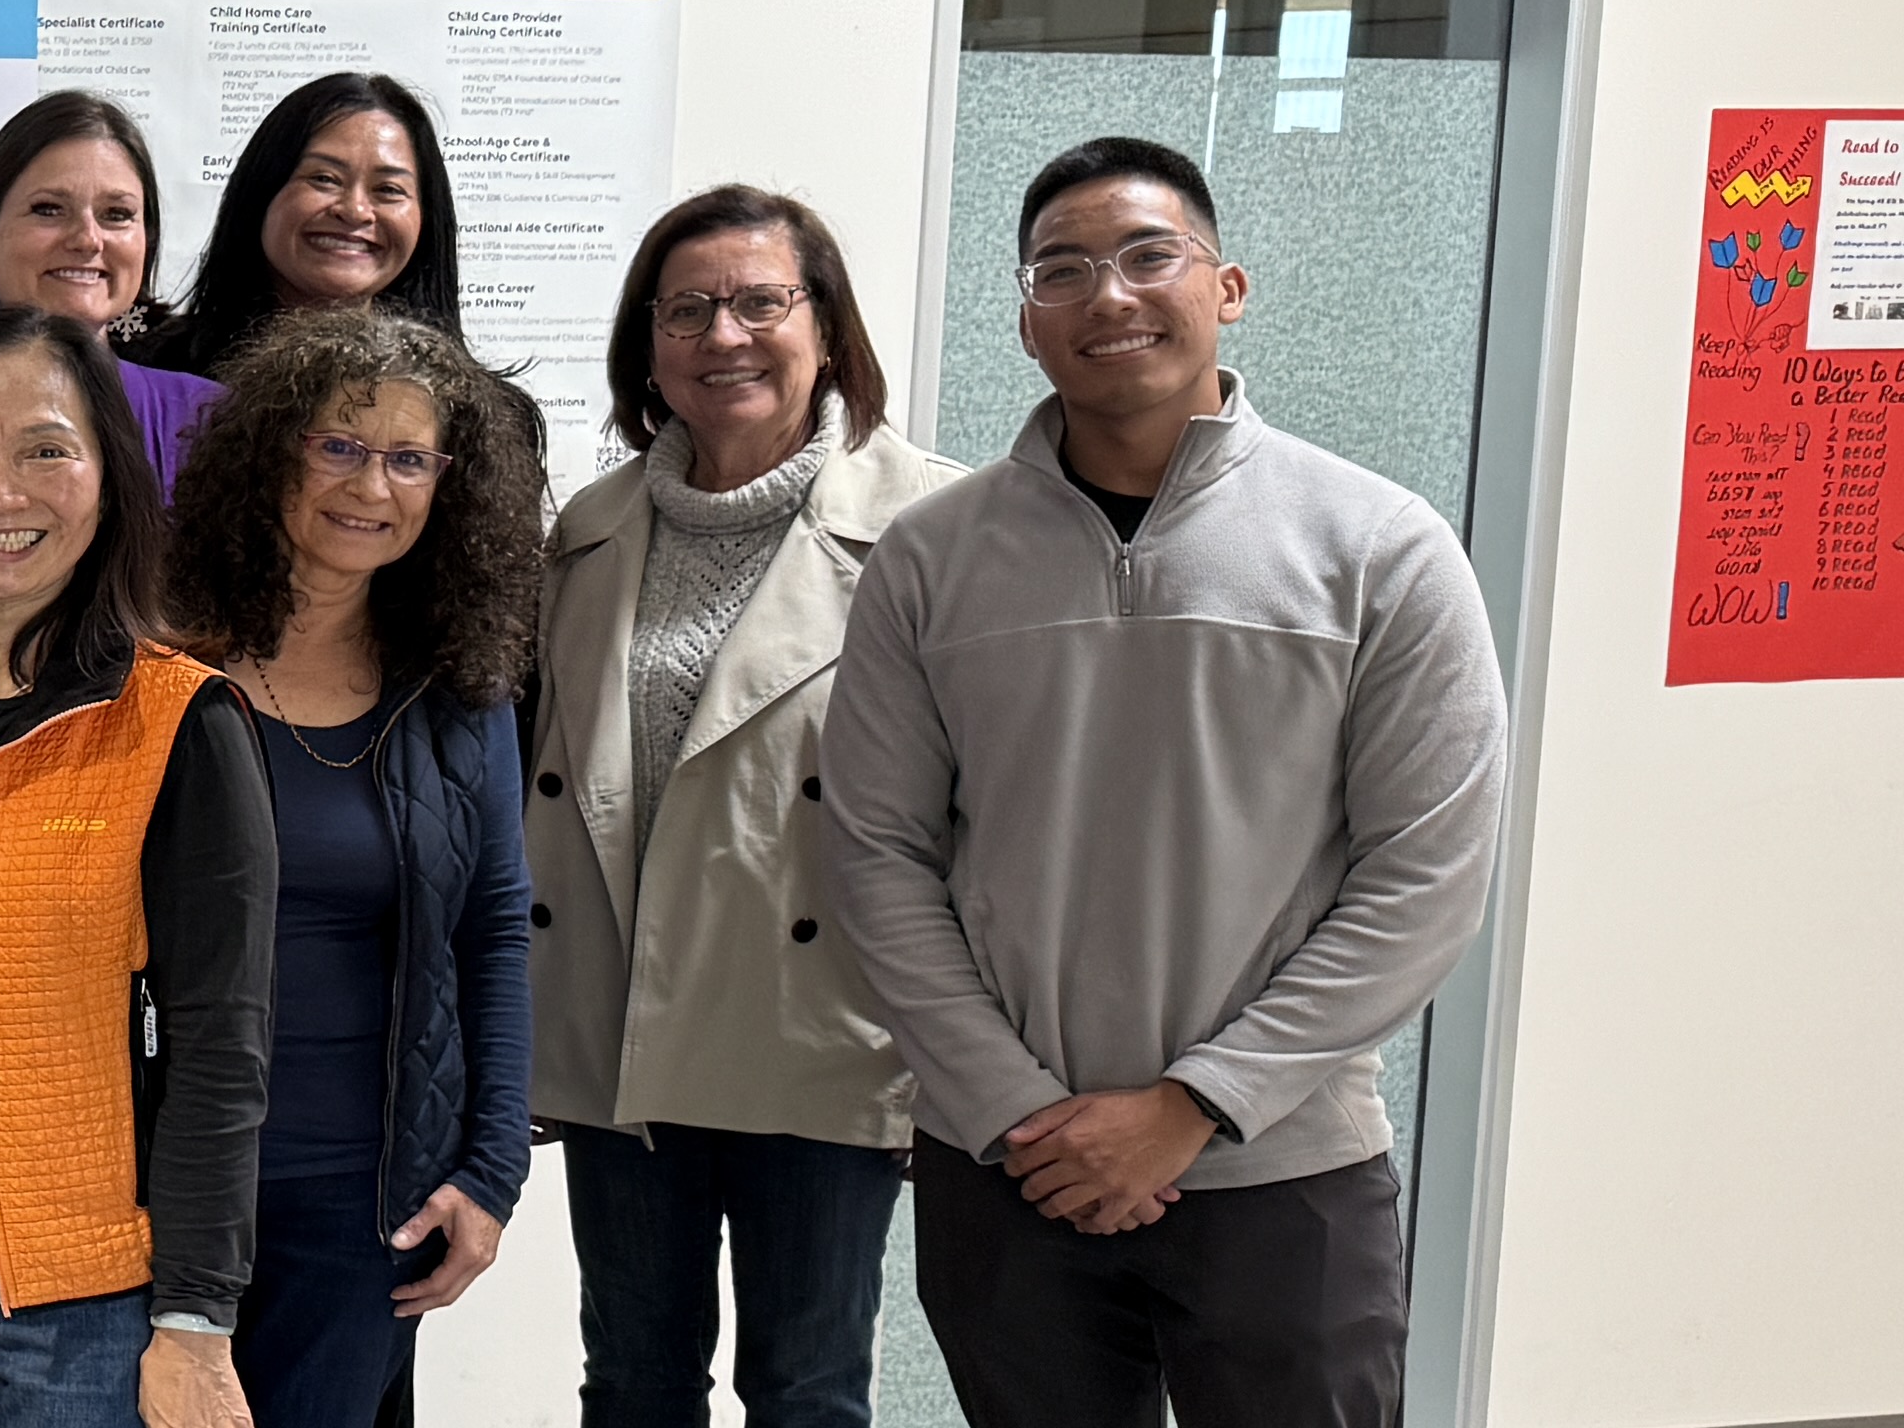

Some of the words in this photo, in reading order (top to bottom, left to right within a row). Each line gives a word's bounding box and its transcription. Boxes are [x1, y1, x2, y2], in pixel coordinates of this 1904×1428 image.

[210, 7, 241, 17] Child
[246, 7, 280, 18] Home
[285, 8, 312, 18] Care
[448, 12, 478, 22] Child
[482, 12, 509, 22] Care
[513, 12, 562, 22] Provider
[37, 17, 95, 29] Specialist
[100, 18, 164, 28] Certificate
[210, 22, 259, 34] Training
[263, 22, 326, 34] Certificate
[448, 27, 496, 39] Training
[500, 27, 562, 38] Certificate
[513, 138, 539, 147] Care
[1842, 138, 1879, 153] Read
[203, 156, 232, 168] Early
[511, 152, 570, 162] Certificate
[516, 223, 540, 233] Aide
[544, 223, 604, 233] Certificate
[468, 284, 494, 293] Care
[498, 284, 535, 293] Career
[476, 299, 526, 310] Pathway
[1697, 333, 1735, 359] Keep
[1698, 361, 1761, 391] Reading
[1783, 357, 1807, 384] 10
[1813, 357, 1863, 388] Ways
[1870, 360, 1887, 383] to
[1792, 392, 1803, 406] a
[1814, 385, 1868, 405] Better
[1830, 408, 1837, 423] 1
[1849, 407, 1887, 423] Read
[1826, 429, 1838, 442] 2
[1846, 426, 1887, 441] Read
[1824, 446, 1835, 460] 3
[1843, 446, 1887, 460] Read
[1824, 464, 1834, 479] 4
[1841, 464, 1886, 478] Read
[1821, 483, 1832, 497] 5
[1838, 482, 1879, 497] Read
[1819, 501, 1829, 517] 6
[1834, 500, 1880, 517] Read
[1819, 521, 1829, 535] 7
[1833, 521, 1879, 535] Read
[1817, 538, 1827, 554] 8
[1832, 538, 1878, 553] Read
[1817, 558, 1826, 573] 9
[1833, 556, 1877, 572] Read
[1812, 575, 1827, 590] 10
[1833, 573, 1877, 590] Read
